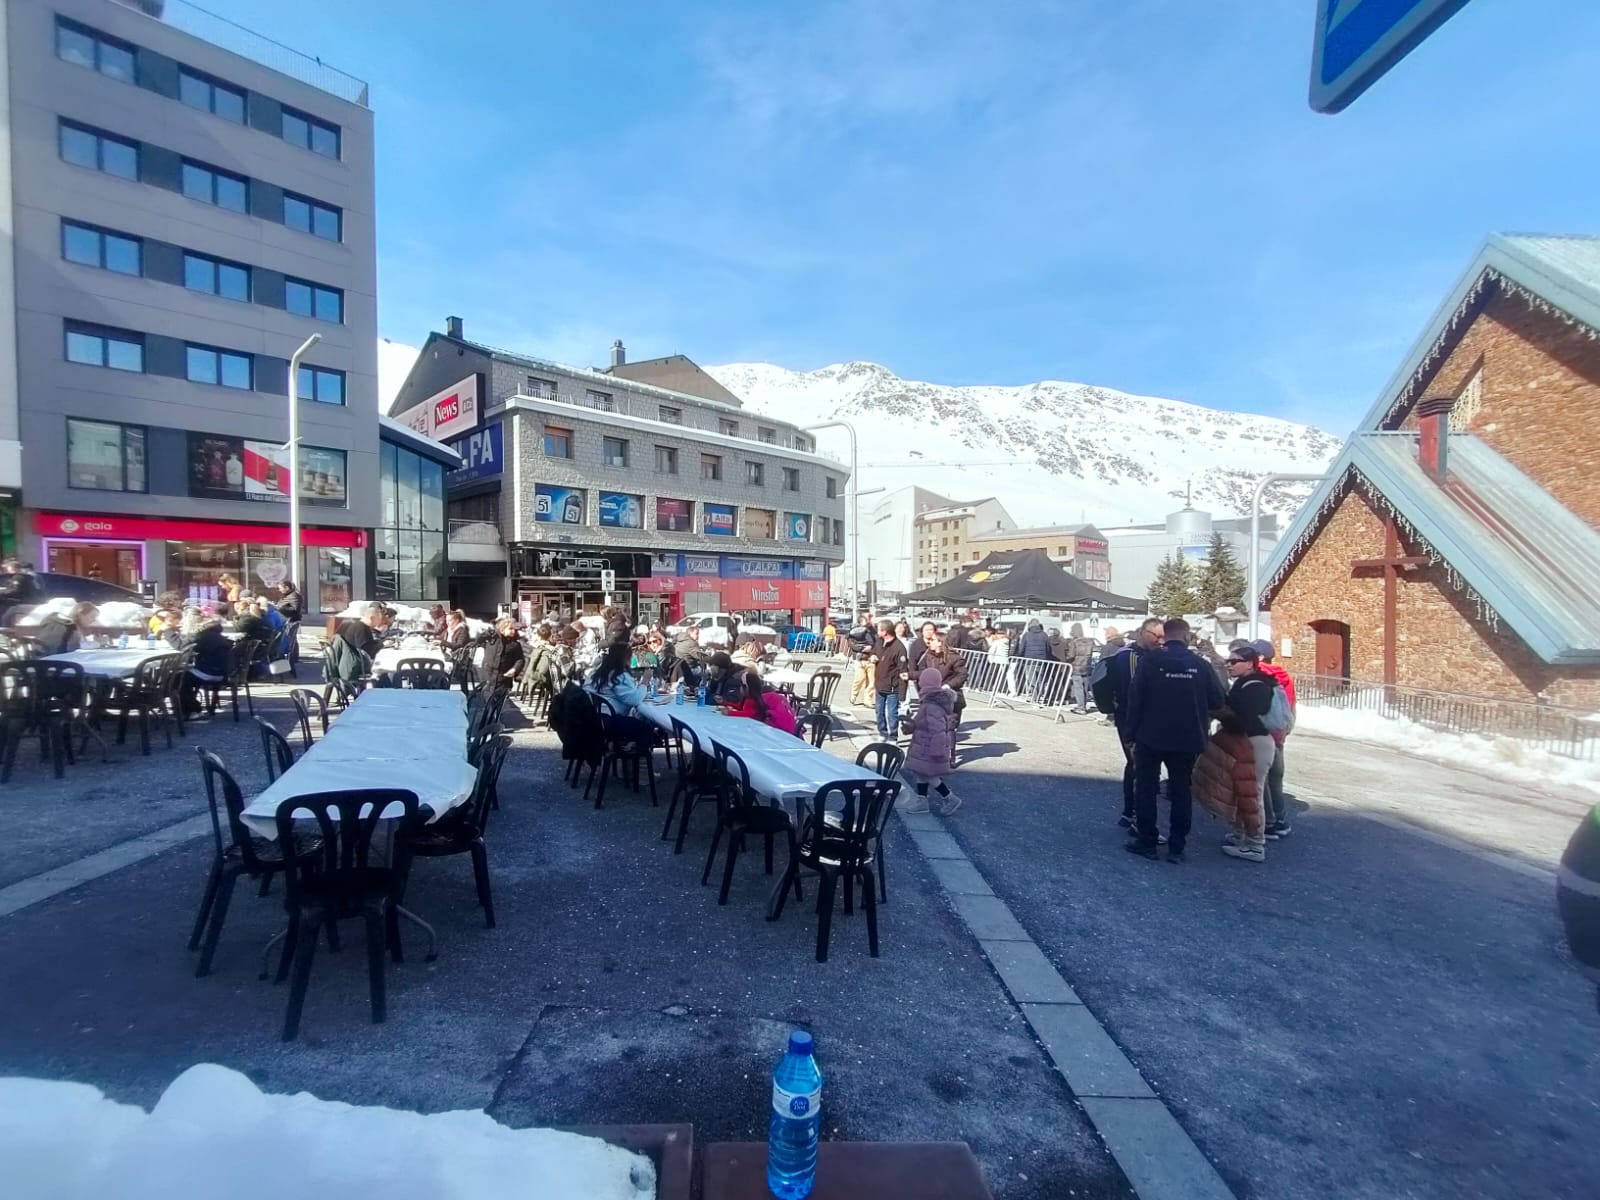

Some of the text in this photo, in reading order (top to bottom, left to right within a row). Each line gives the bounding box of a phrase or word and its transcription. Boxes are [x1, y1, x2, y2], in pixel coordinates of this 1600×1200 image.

[435, 400, 458, 422] News
[538, 499, 549, 512] 51
[568, 510, 578, 520] 51
[565, 559, 604, 570] JAIS
[755, 561, 780, 571] ALFA
[751, 587, 779, 602] Winston
